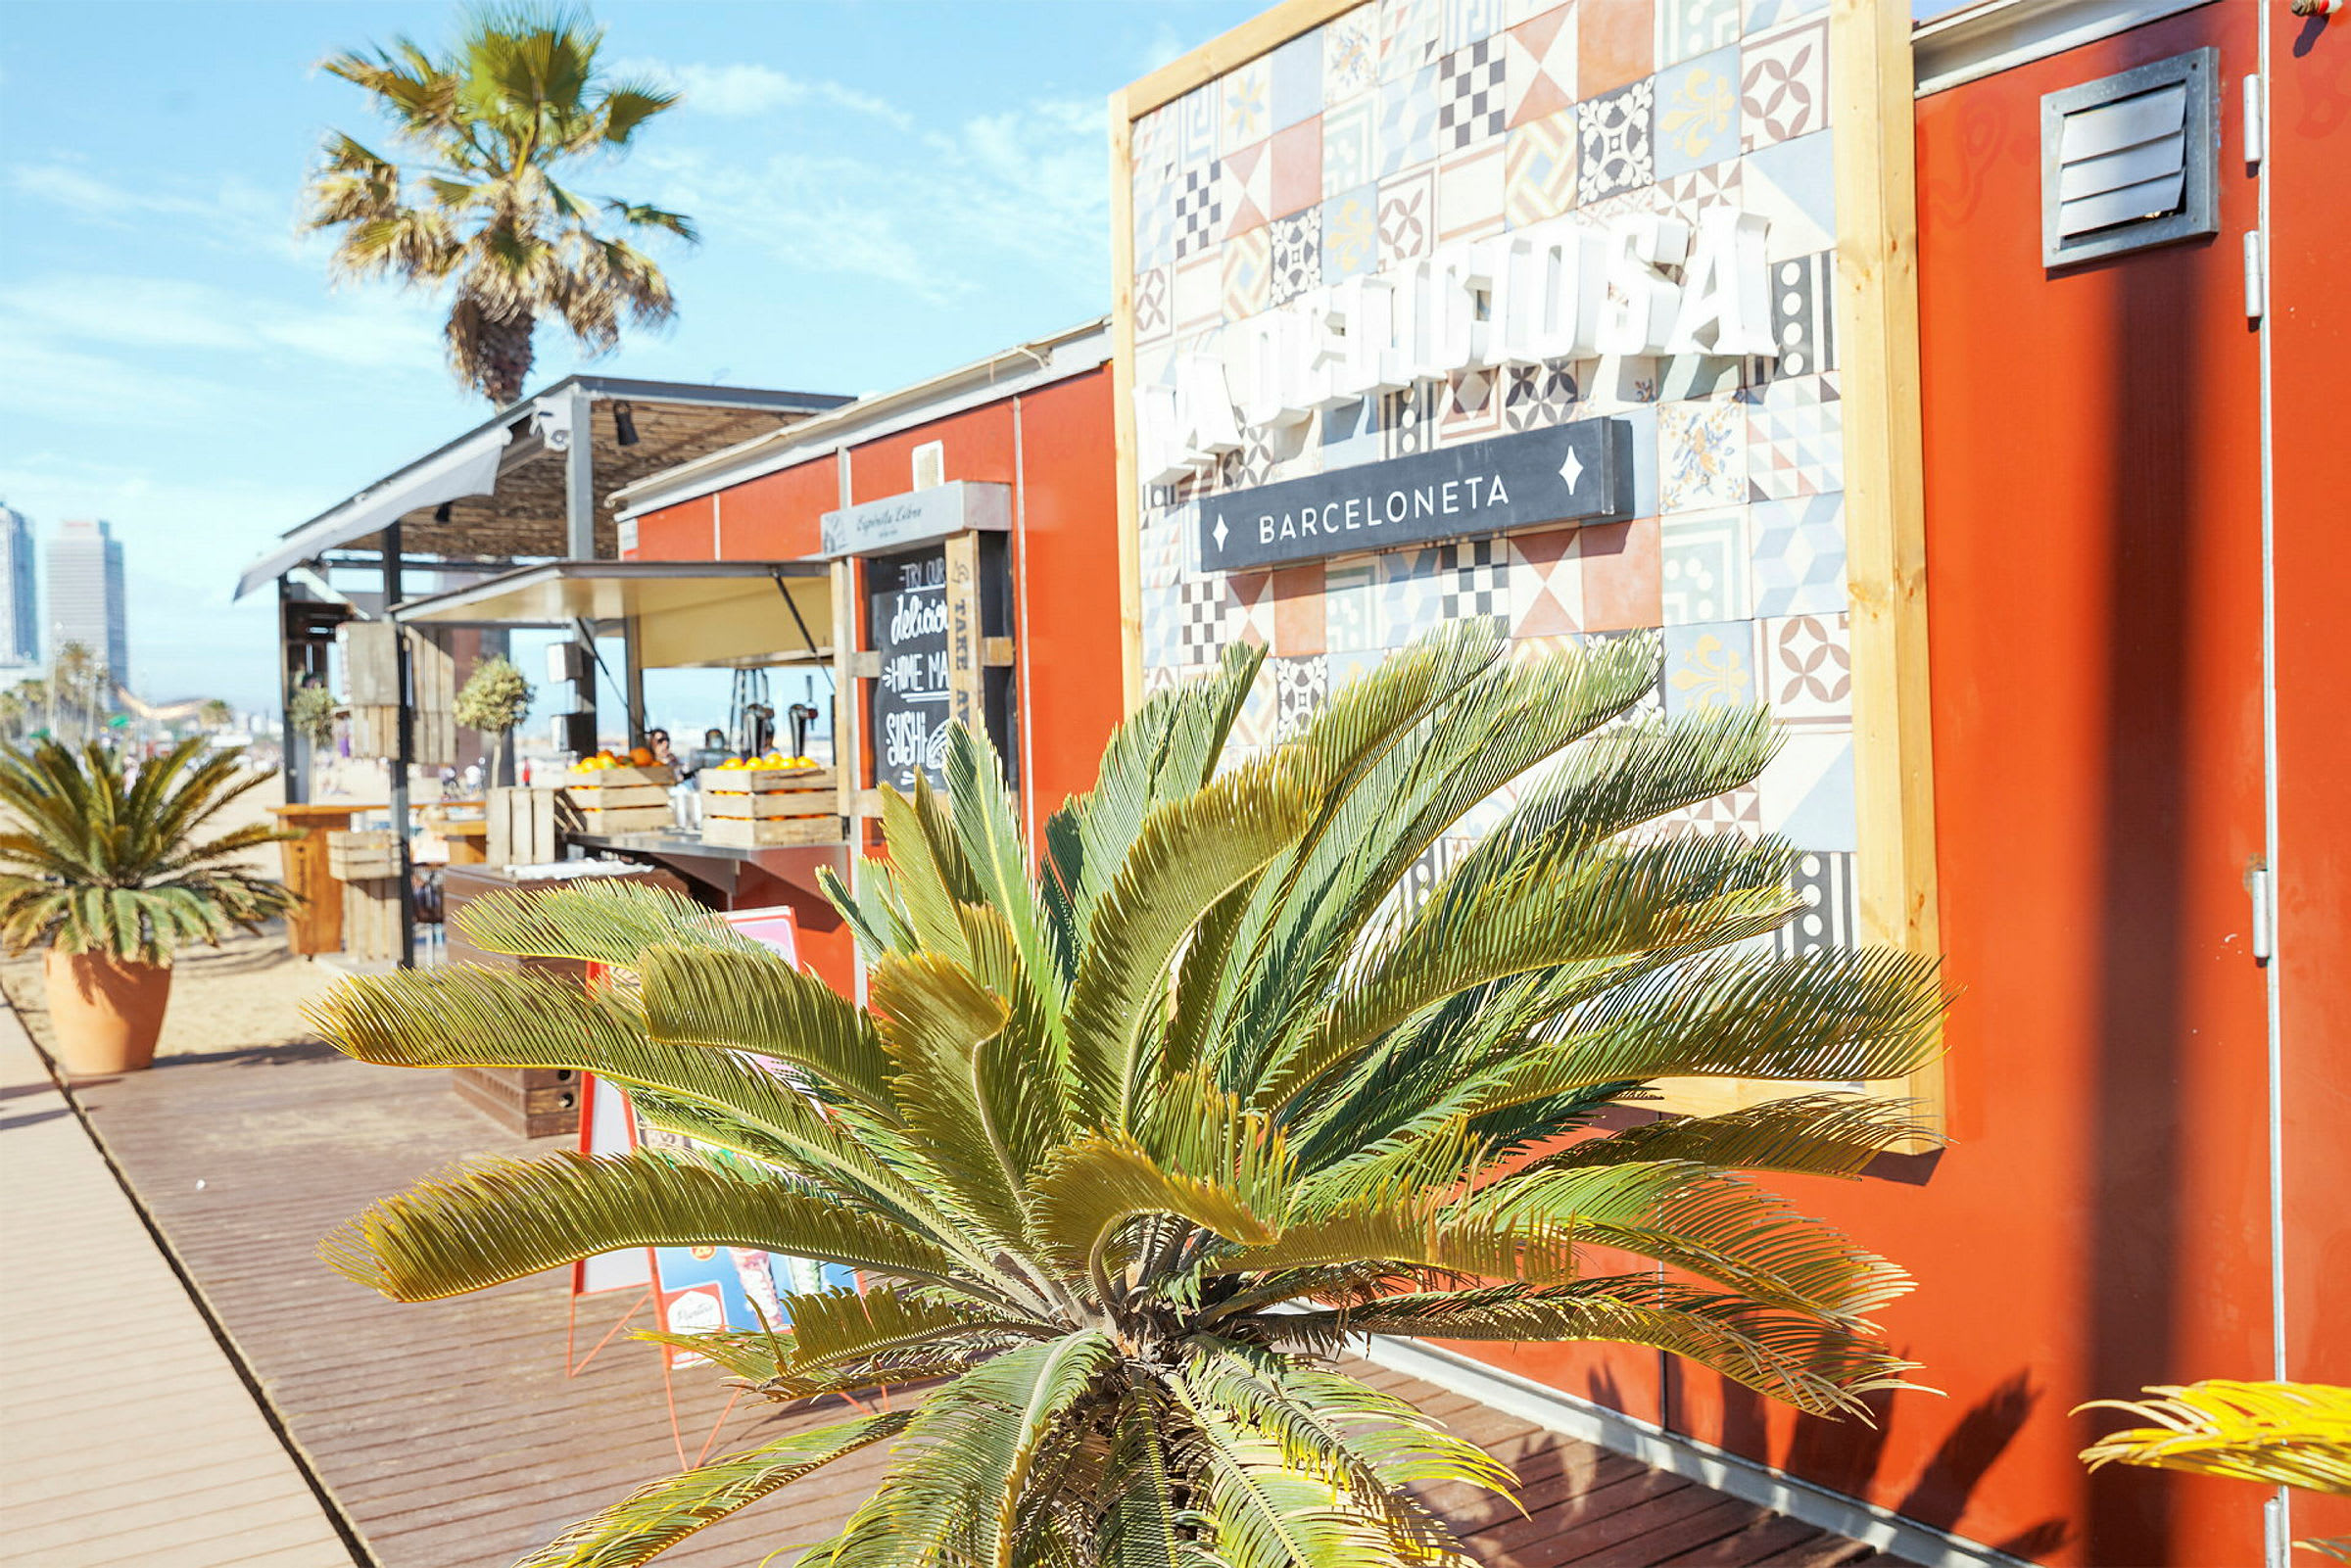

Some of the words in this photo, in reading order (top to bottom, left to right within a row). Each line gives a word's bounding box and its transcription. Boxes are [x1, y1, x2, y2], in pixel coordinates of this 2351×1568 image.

[1231, 208, 1780, 427] DELICIOSA
[1259, 474, 1510, 545] BARCELONETA
[926, 556, 945, 586] OUR
[954, 598, 969, 671] TAKE
[891, 653, 923, 693] HOME
[928, 650, 949, 690] MA
